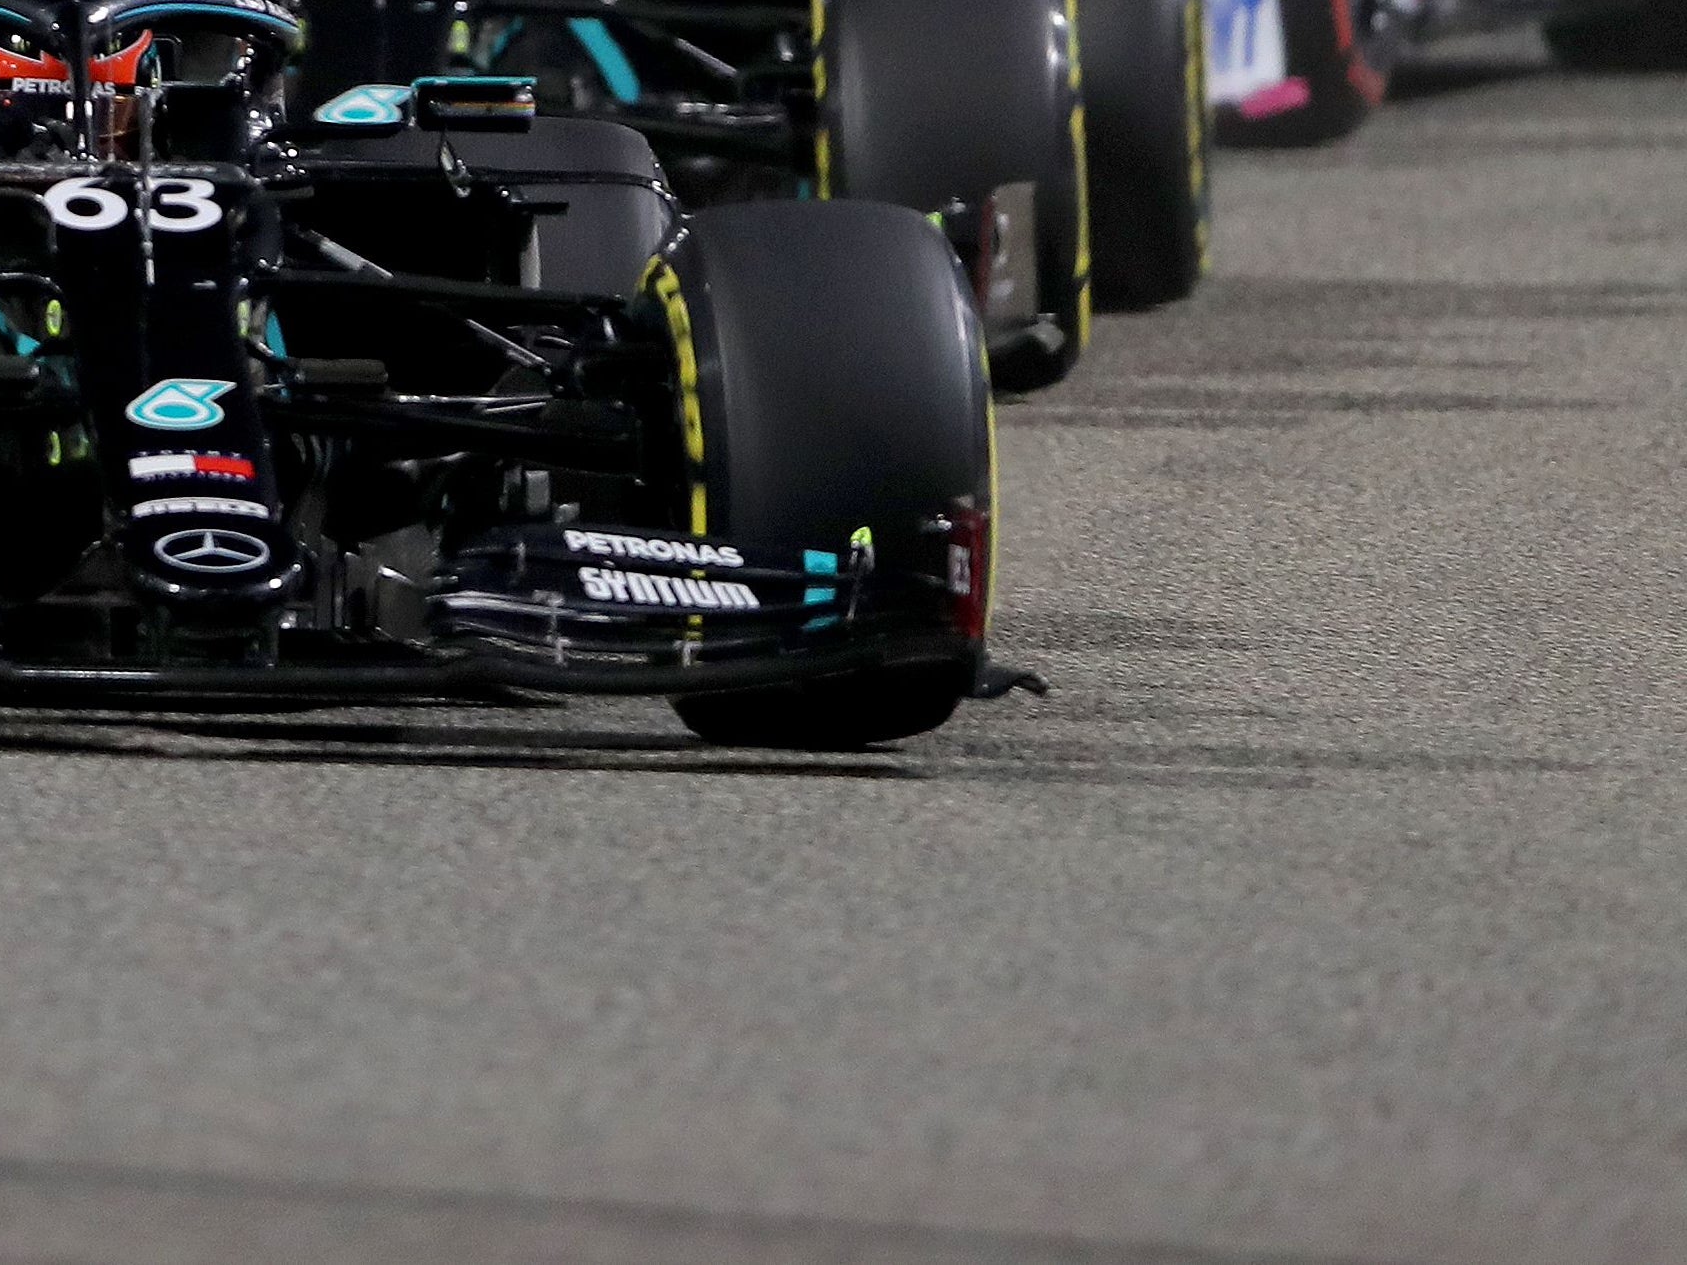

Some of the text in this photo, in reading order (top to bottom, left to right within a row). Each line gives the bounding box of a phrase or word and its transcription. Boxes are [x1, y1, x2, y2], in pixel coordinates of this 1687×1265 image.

[43, 175, 223, 233] 63
[563, 529, 745, 568] PETRONAS
[578, 566, 761, 610] SYNTIUM
